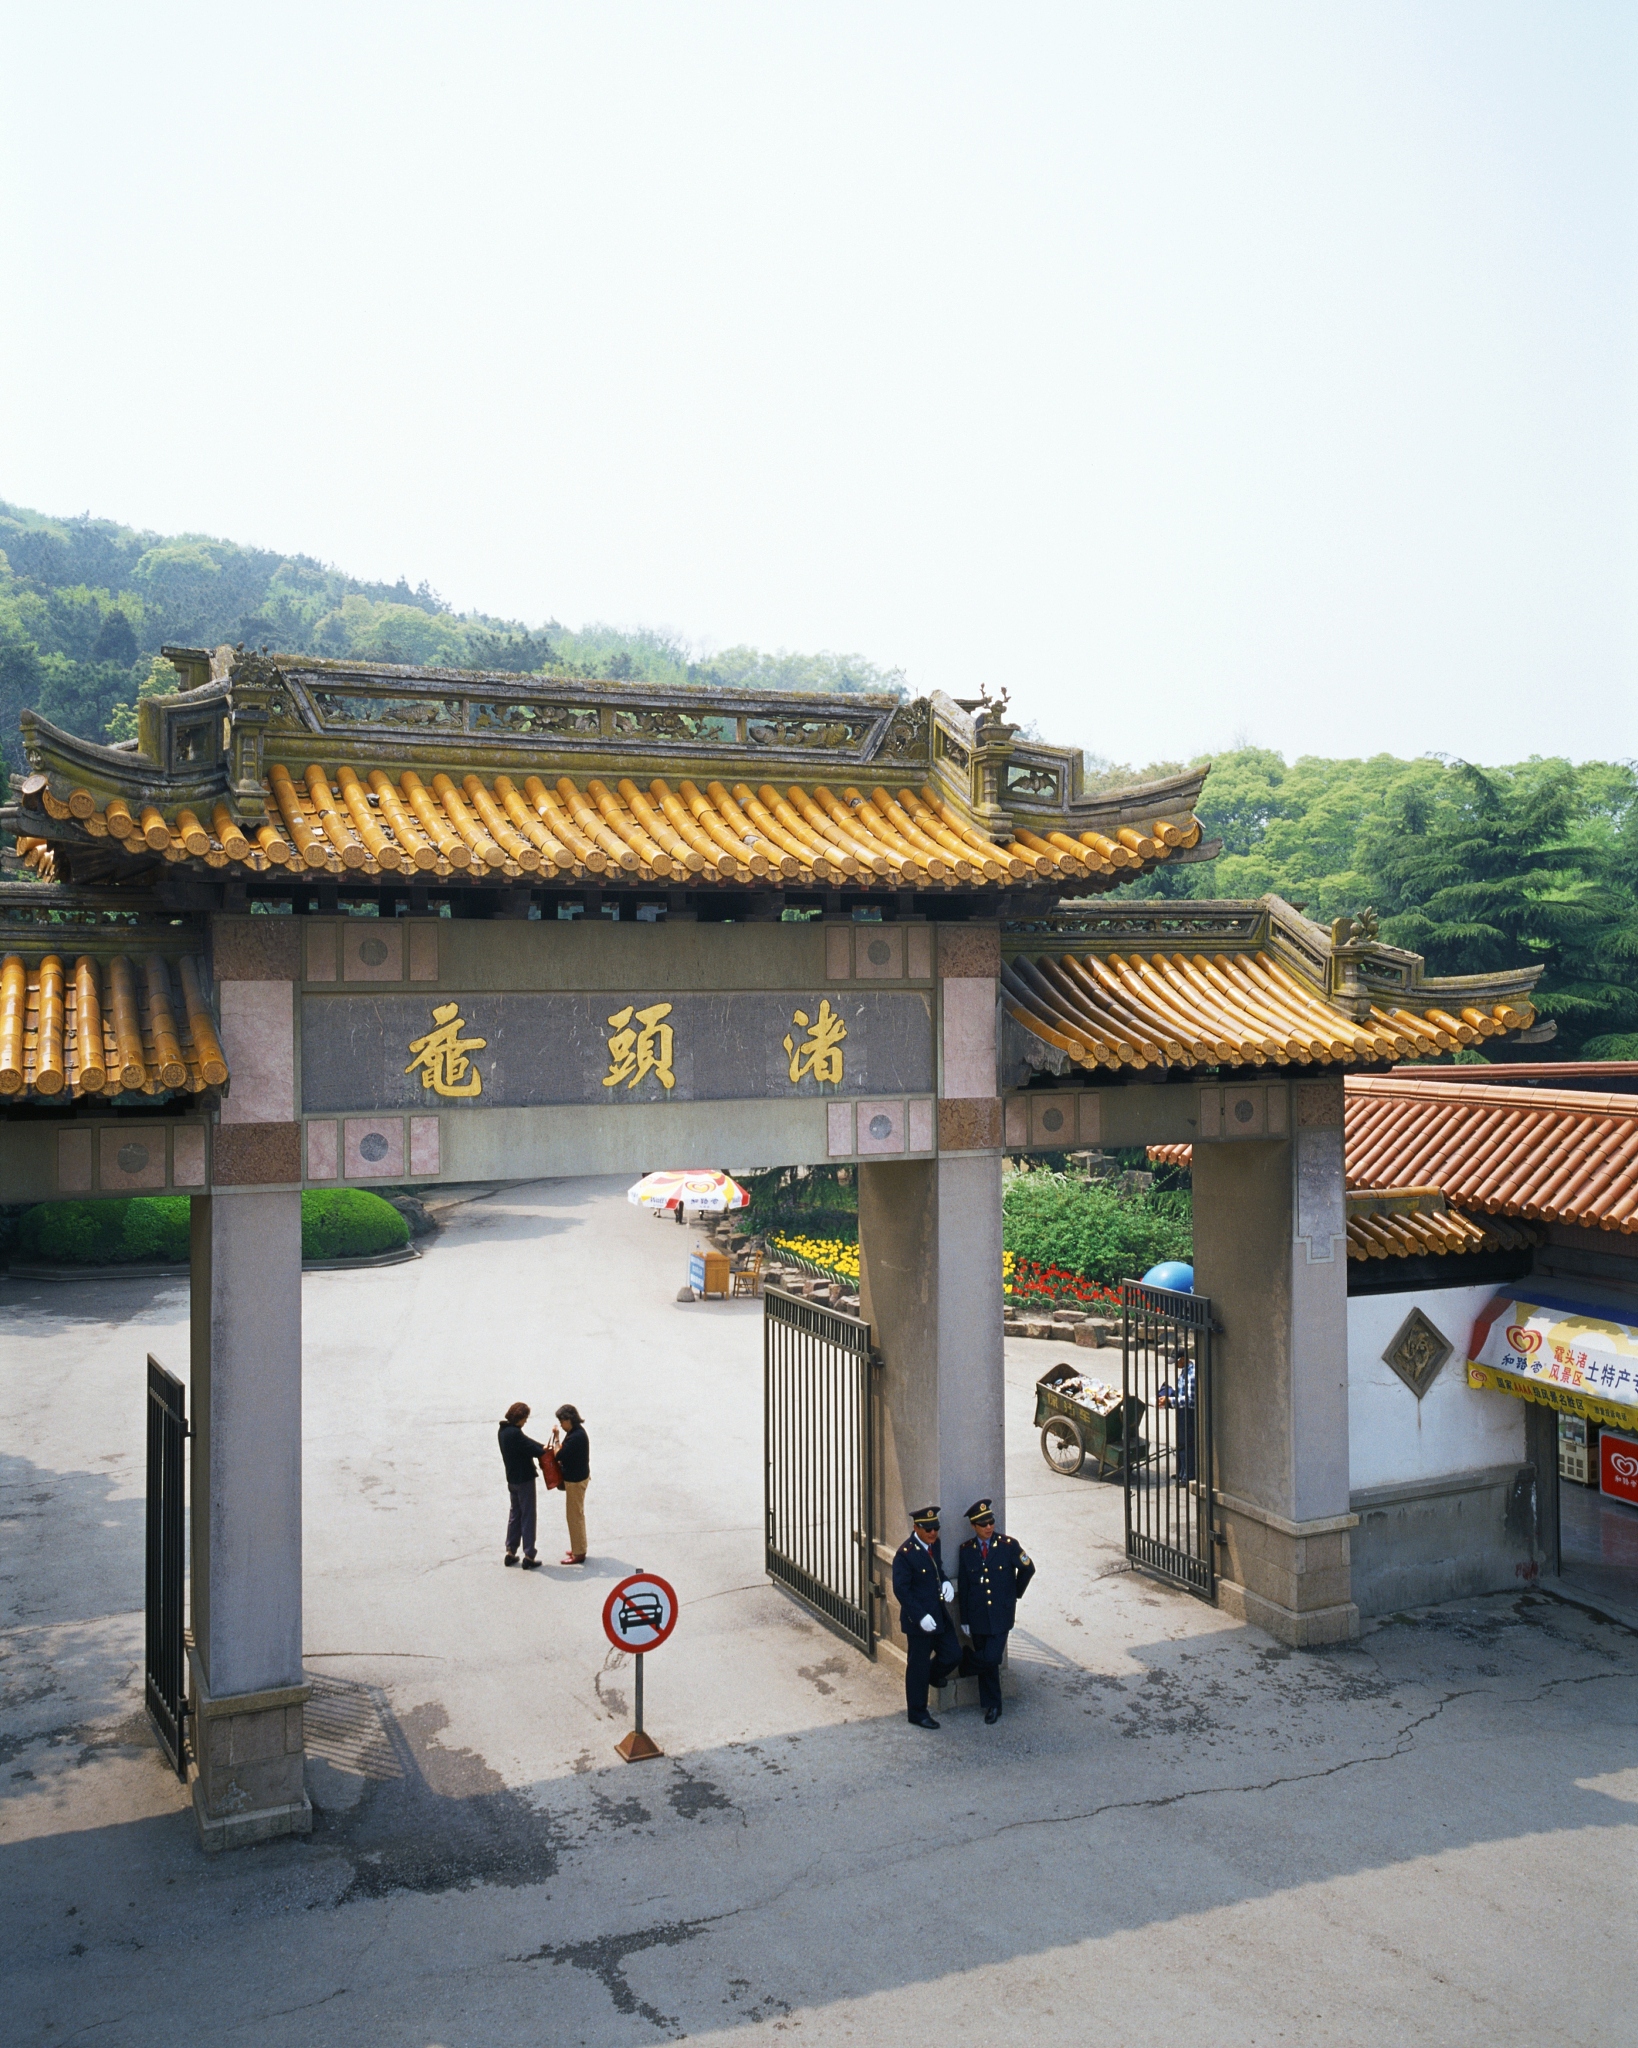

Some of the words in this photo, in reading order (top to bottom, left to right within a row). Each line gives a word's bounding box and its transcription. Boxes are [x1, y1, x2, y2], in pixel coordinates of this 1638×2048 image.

[1501, 1353, 1543, 1374] 和路雪
[1549, 1363, 1584, 1387] 风景区
